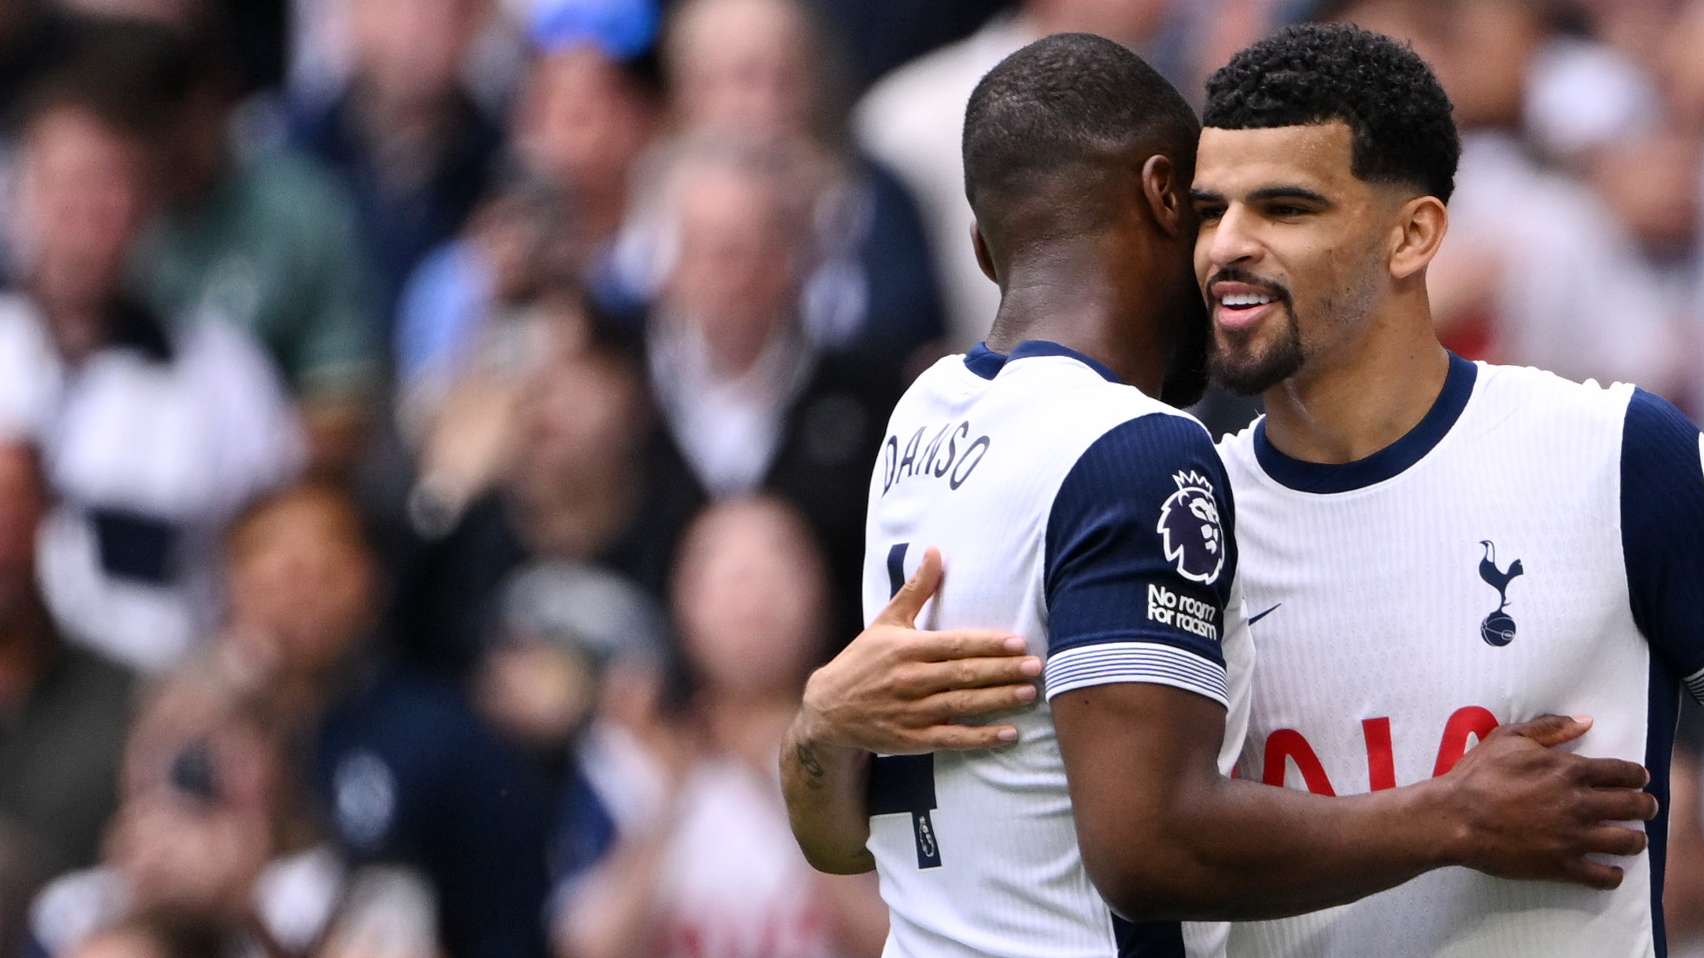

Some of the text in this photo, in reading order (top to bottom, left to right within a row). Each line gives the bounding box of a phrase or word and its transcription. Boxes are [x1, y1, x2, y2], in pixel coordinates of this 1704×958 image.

[881, 421, 991, 497] DANSO
[1148, 583, 1216, 622] No room
[1176, 612, 1217, 640] racism
